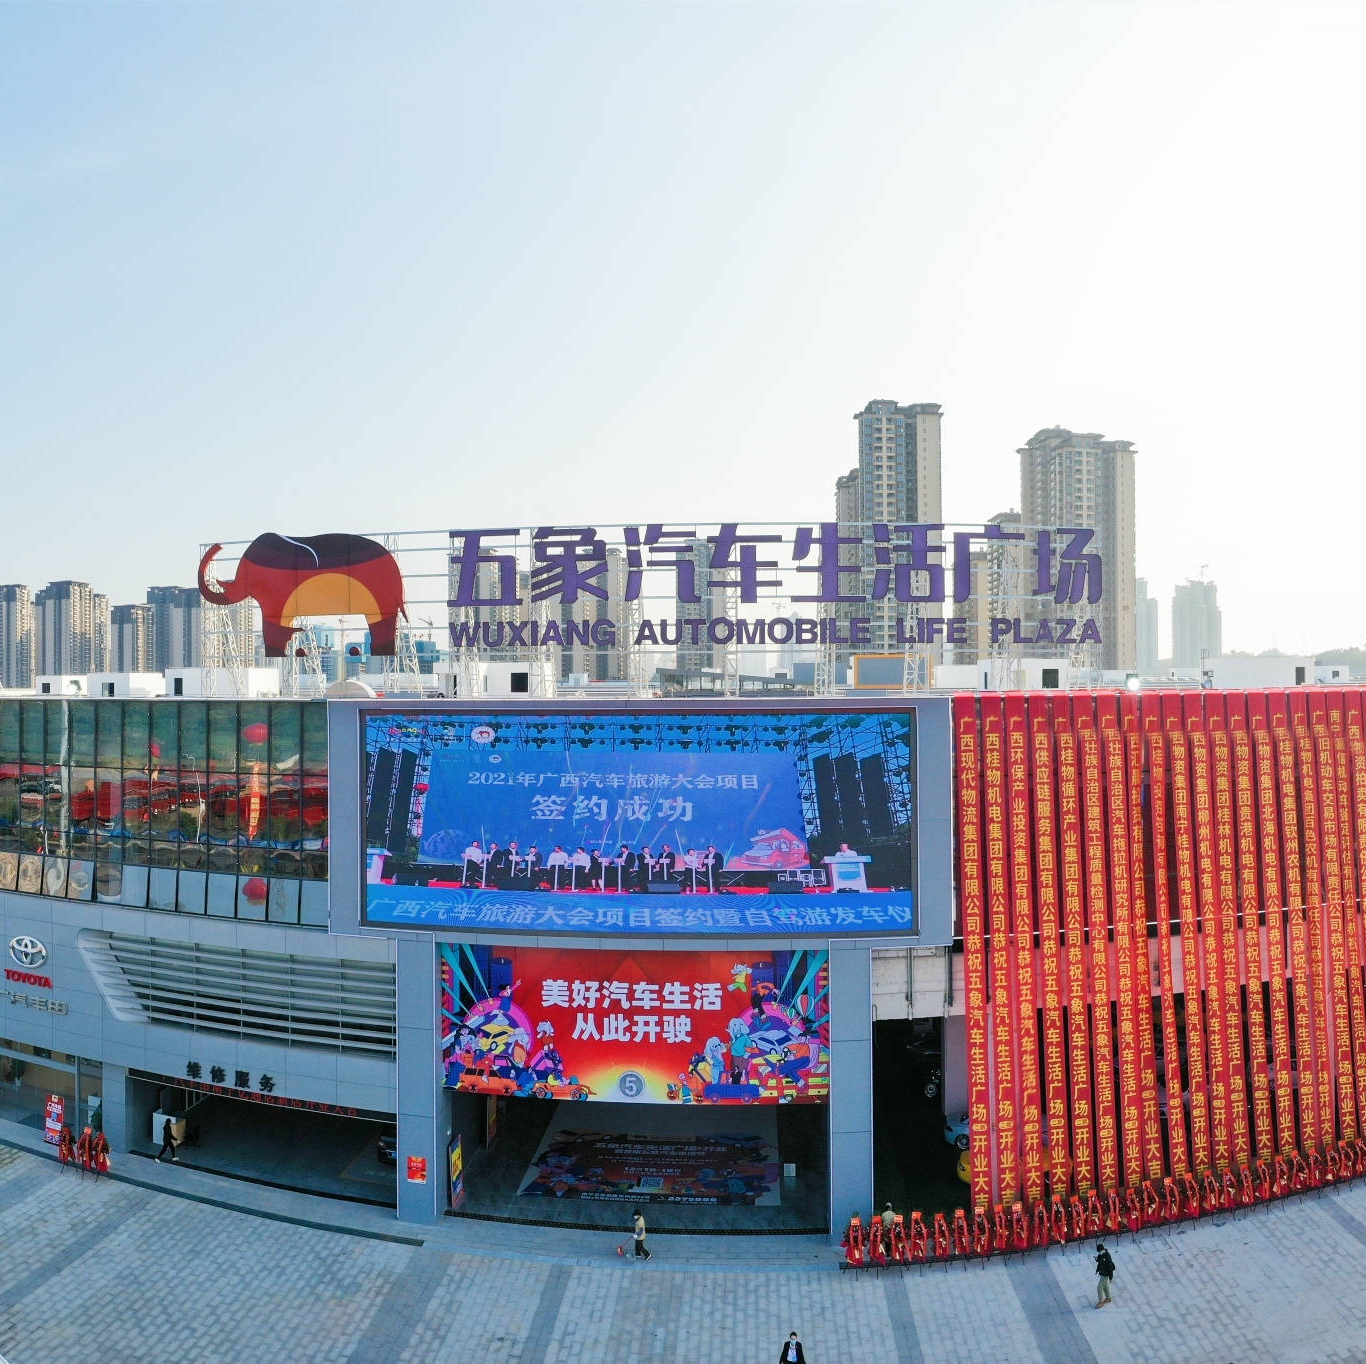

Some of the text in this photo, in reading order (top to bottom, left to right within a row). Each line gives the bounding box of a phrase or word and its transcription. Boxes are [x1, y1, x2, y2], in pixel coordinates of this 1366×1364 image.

[448, 521, 1104, 608] 五象汽车生活广场
[449, 617, 1102, 648] WUXIANG AUTOMOBILE LIFE PLAZA
[467, 769, 761, 792] 2021年广西汽车旅游大会项目
[530, 793, 695, 823] 签约成功
[3, 968, 54, 990] TOYOTA
[541, 978, 723, 1011] 美好汽车生活
[571, 1013, 693, 1044] 从此开驶
[186, 1060, 276, 1093] 维修服务
